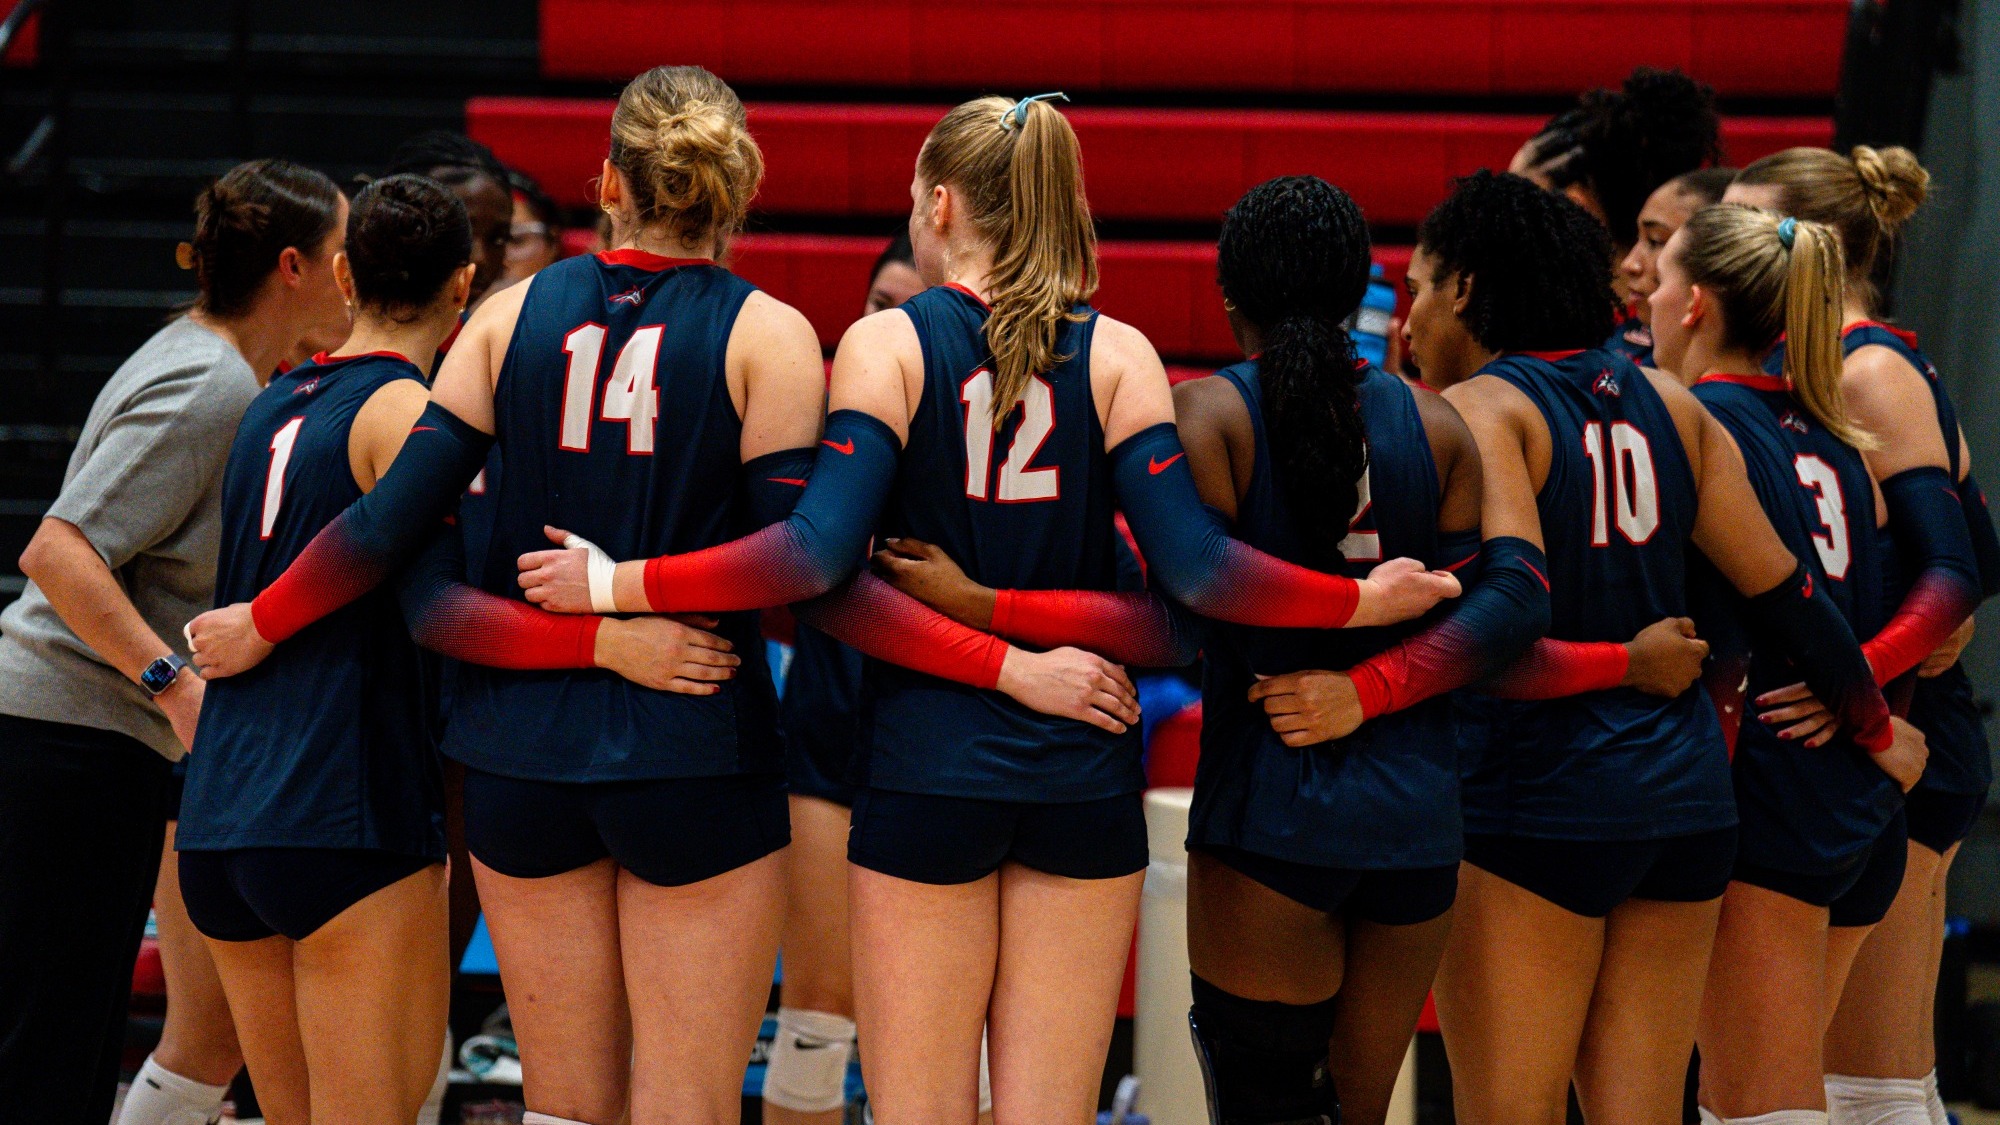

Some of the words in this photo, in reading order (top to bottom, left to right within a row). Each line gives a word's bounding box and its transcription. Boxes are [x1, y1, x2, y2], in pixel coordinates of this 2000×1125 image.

[559, 320, 666, 455] 14
[960, 366, 1060, 503] 12
[260, 415, 306, 540] 1
[1582, 419, 1660, 547] 10
[1793, 452, 1853, 582] 3
